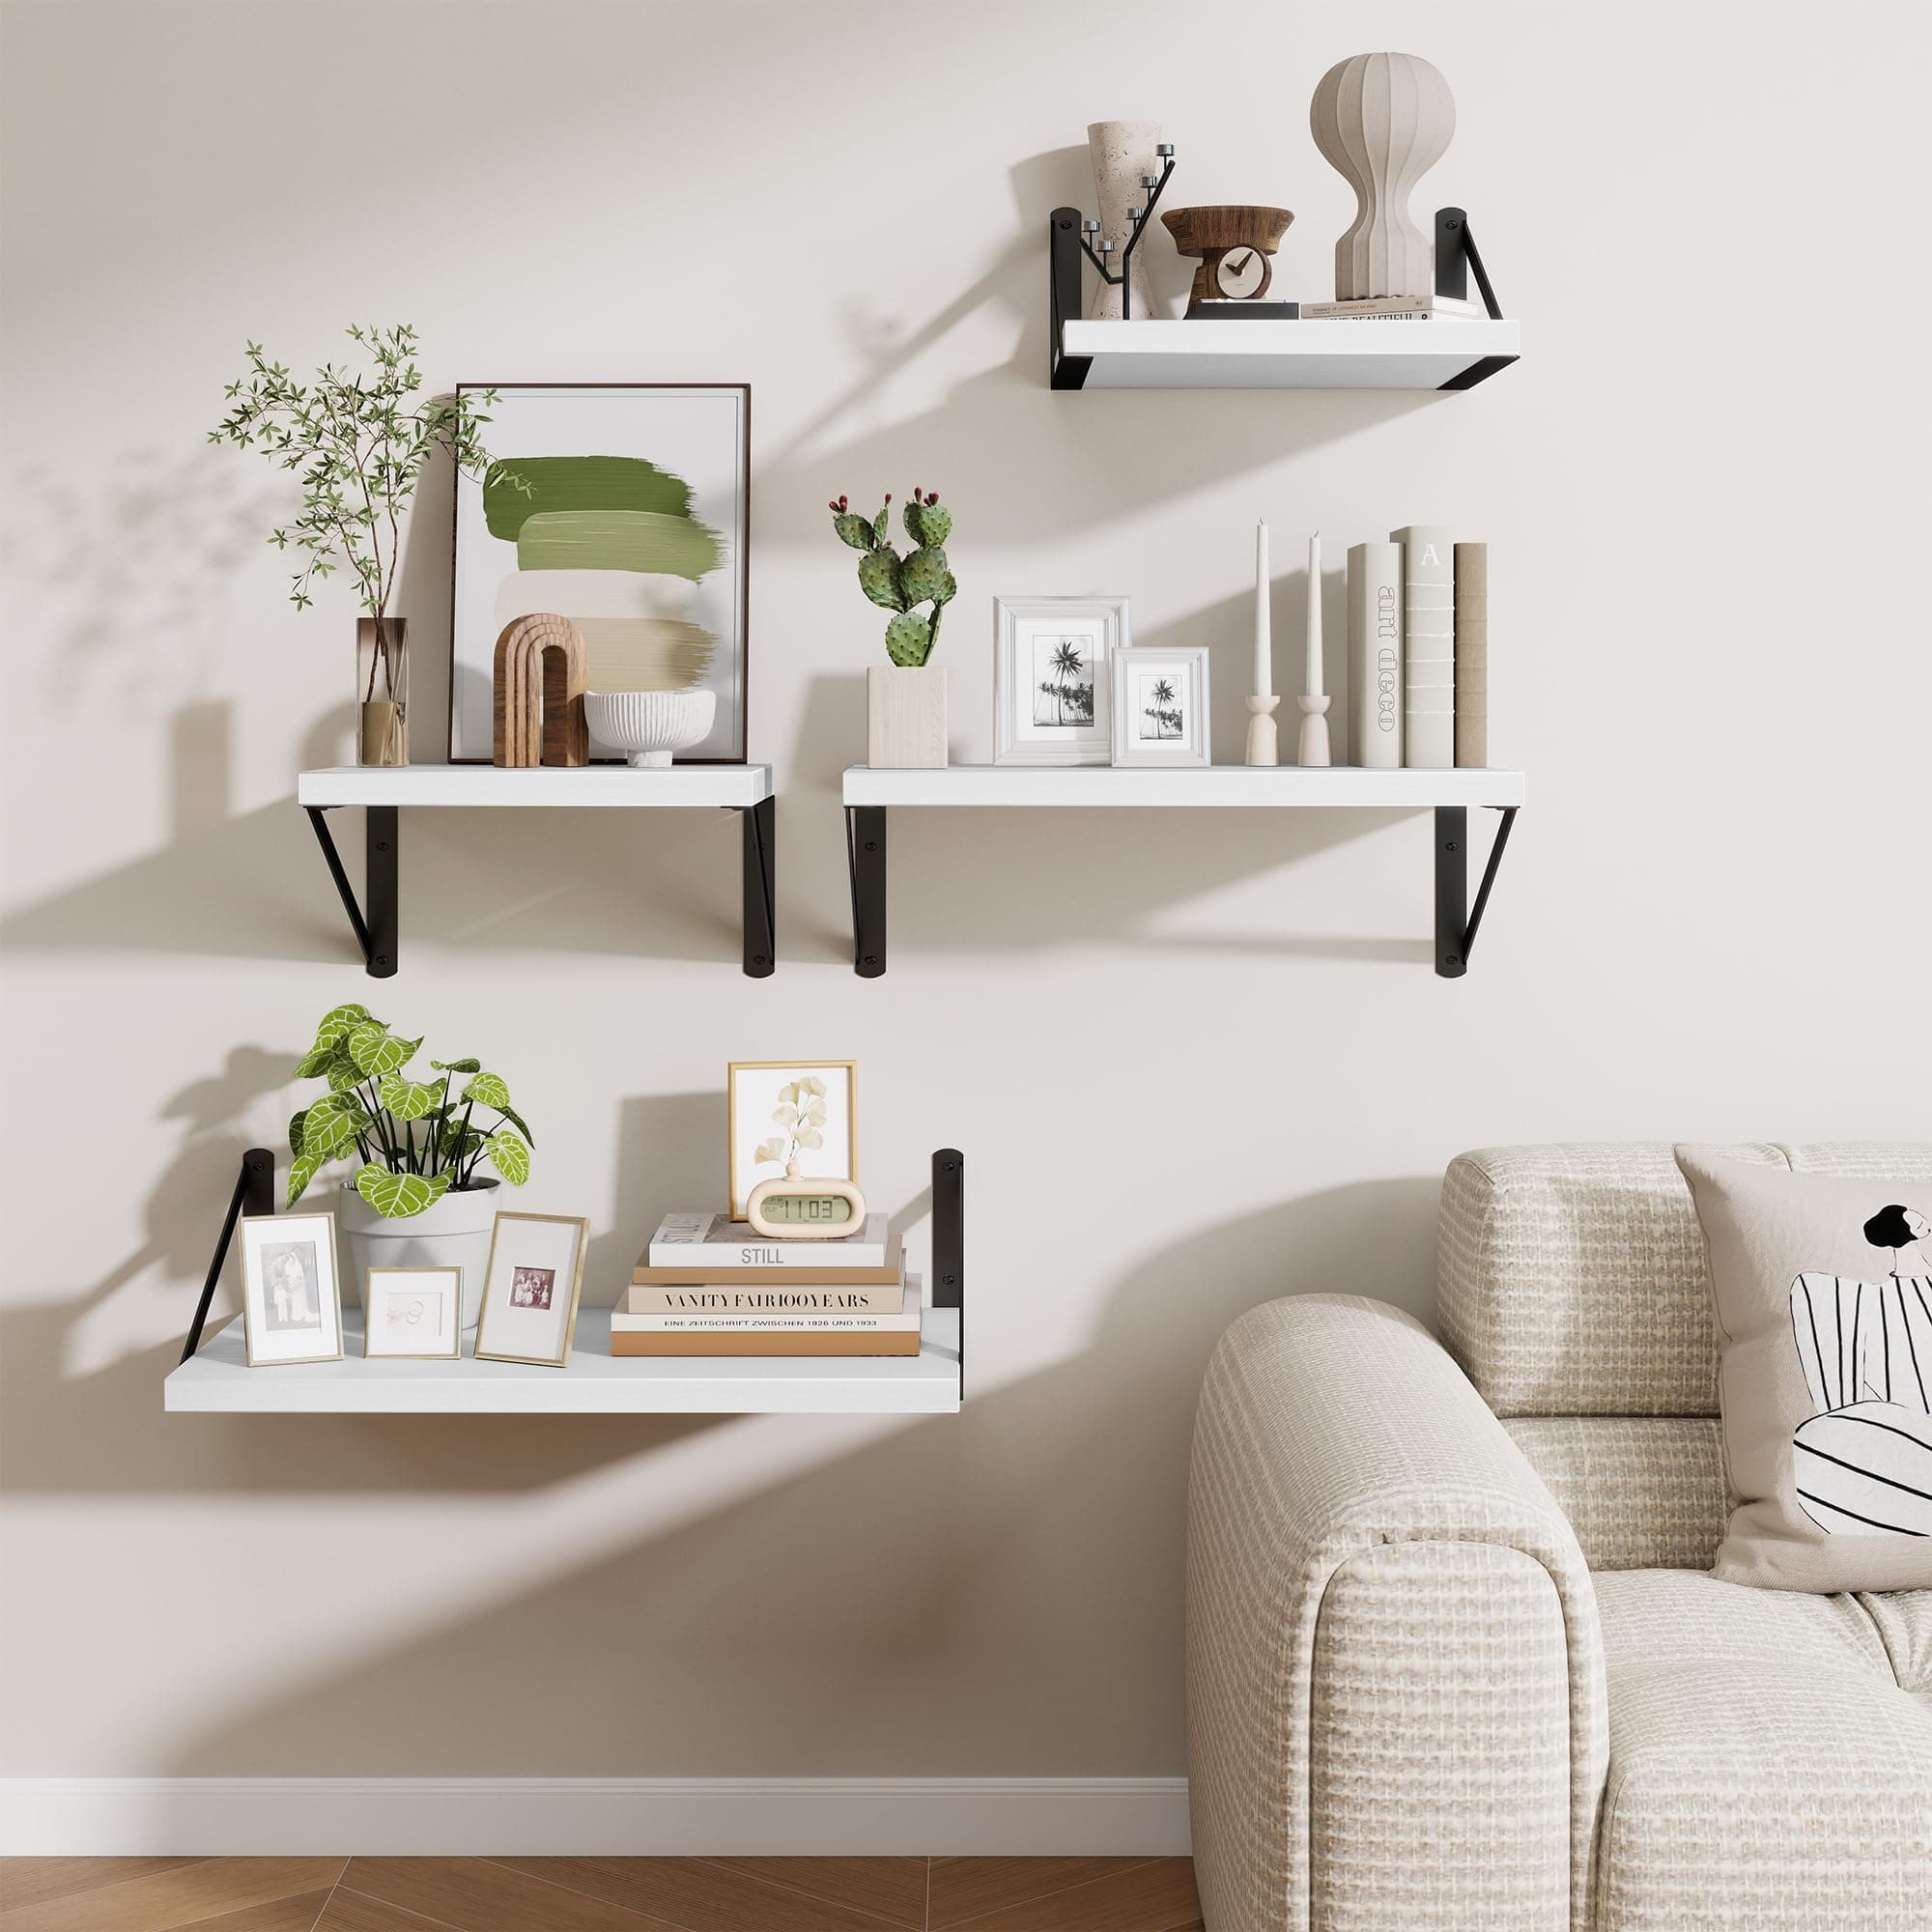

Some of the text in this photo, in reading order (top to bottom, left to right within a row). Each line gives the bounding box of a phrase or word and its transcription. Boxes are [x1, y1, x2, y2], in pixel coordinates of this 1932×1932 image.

[1420, 542, 1441, 566] A
[1378, 586, 1398, 732] art deco
[741, 1248, 784, 1264] STILL
[665, 1293, 730, 1307] VANITY
